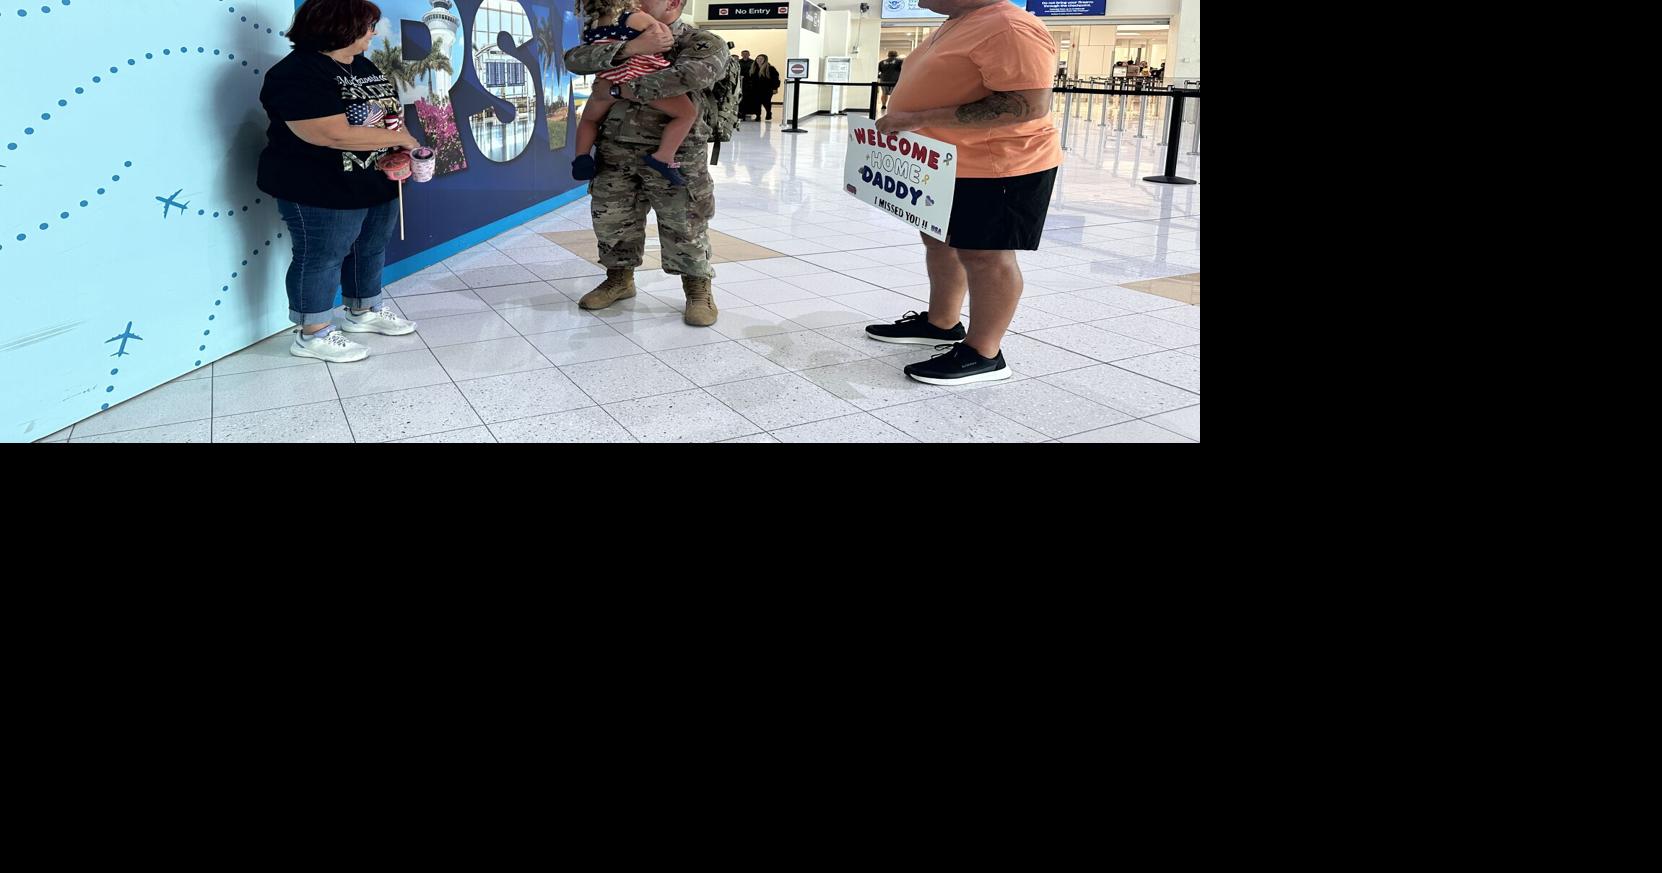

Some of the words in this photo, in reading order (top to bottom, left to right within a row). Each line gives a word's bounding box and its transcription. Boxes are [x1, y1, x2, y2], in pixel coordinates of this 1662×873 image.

[854, 127, 940, 170] WELCOME
[862, 165, 923, 206] DADDY
[871, 151, 922, 184] HOME
[874, 196, 878, 205] I
[879, 199, 904, 218] MISSED
[906, 212, 921, 226] YOU
